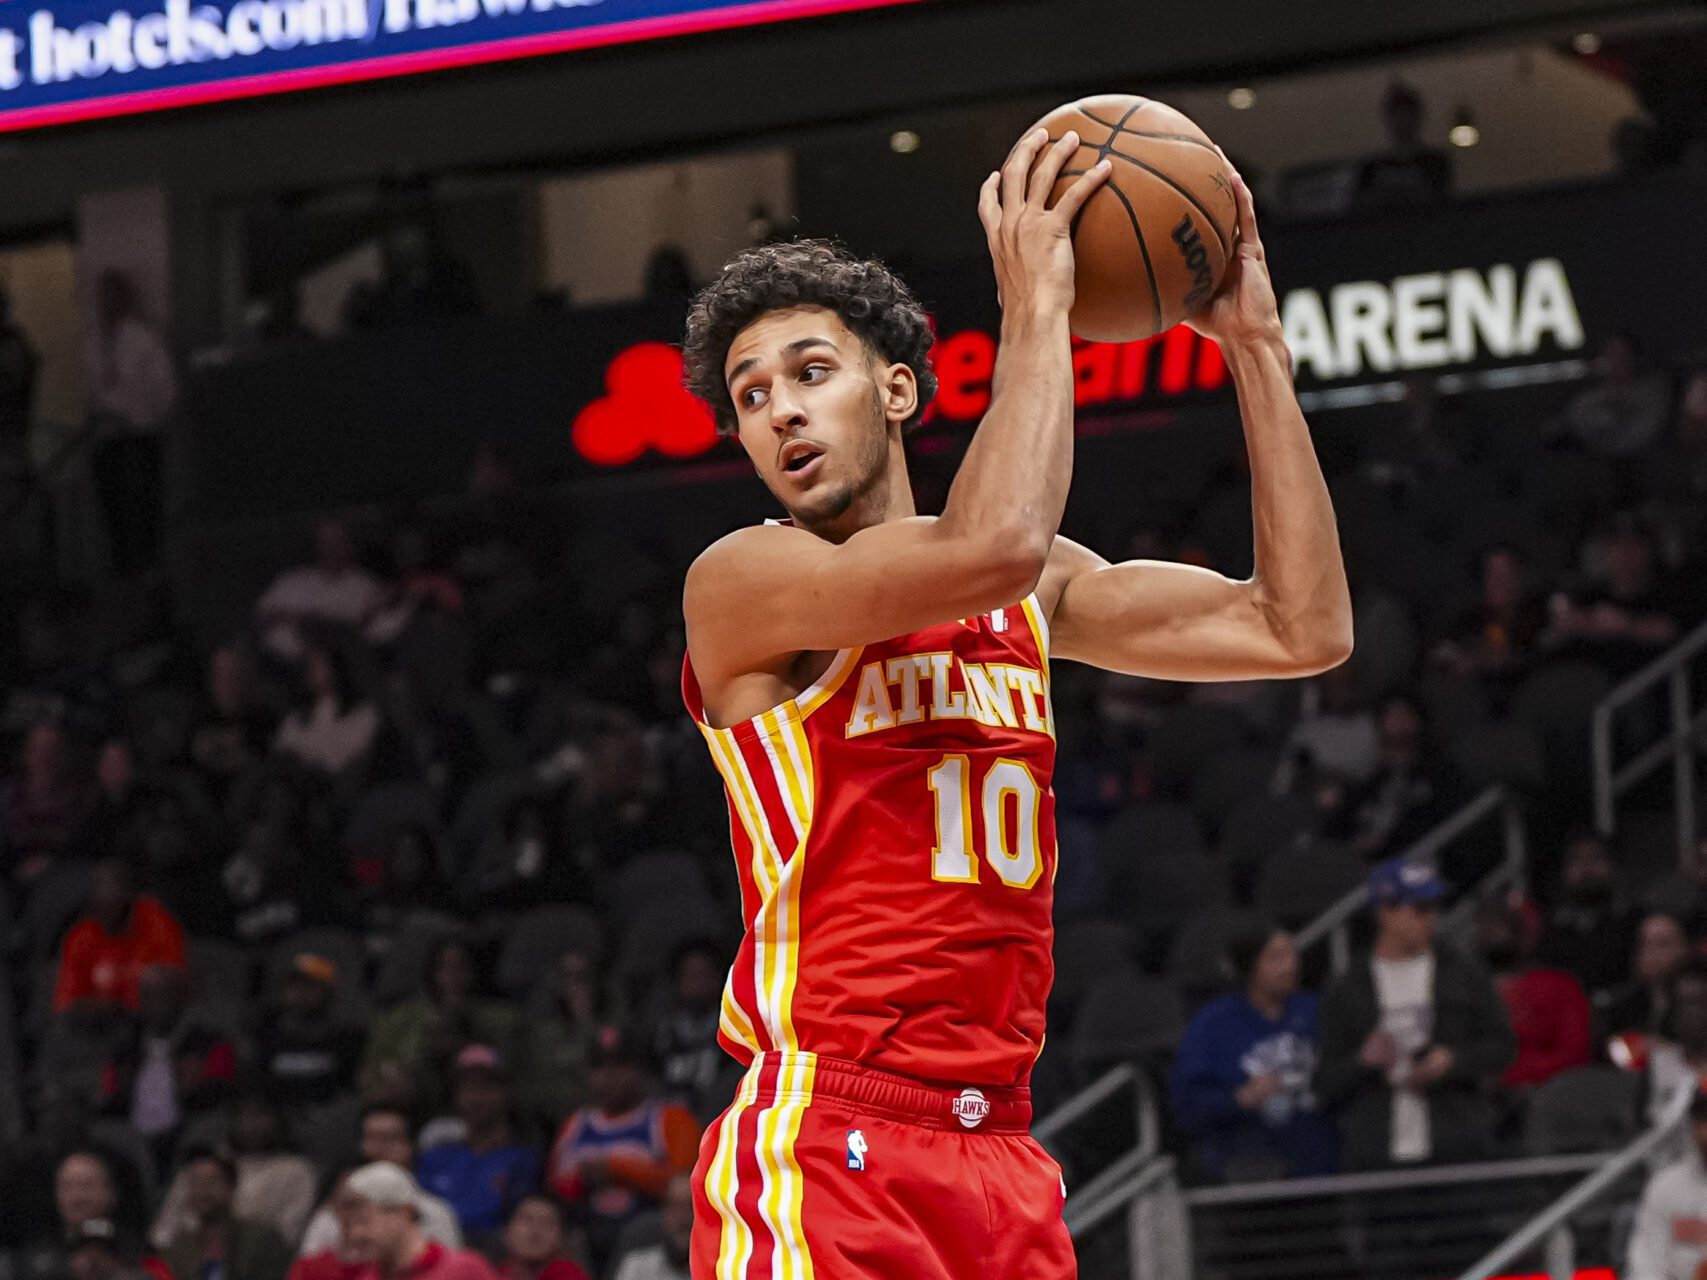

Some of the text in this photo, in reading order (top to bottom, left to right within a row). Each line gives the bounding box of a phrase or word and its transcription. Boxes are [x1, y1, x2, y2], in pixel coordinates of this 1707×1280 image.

[1282, 257, 1586, 380] ARENA
[845, 650, 1056, 740] ATLNT
[927, 753, 1042, 890] 10
[952, 1098, 990, 1117] HAWKS
